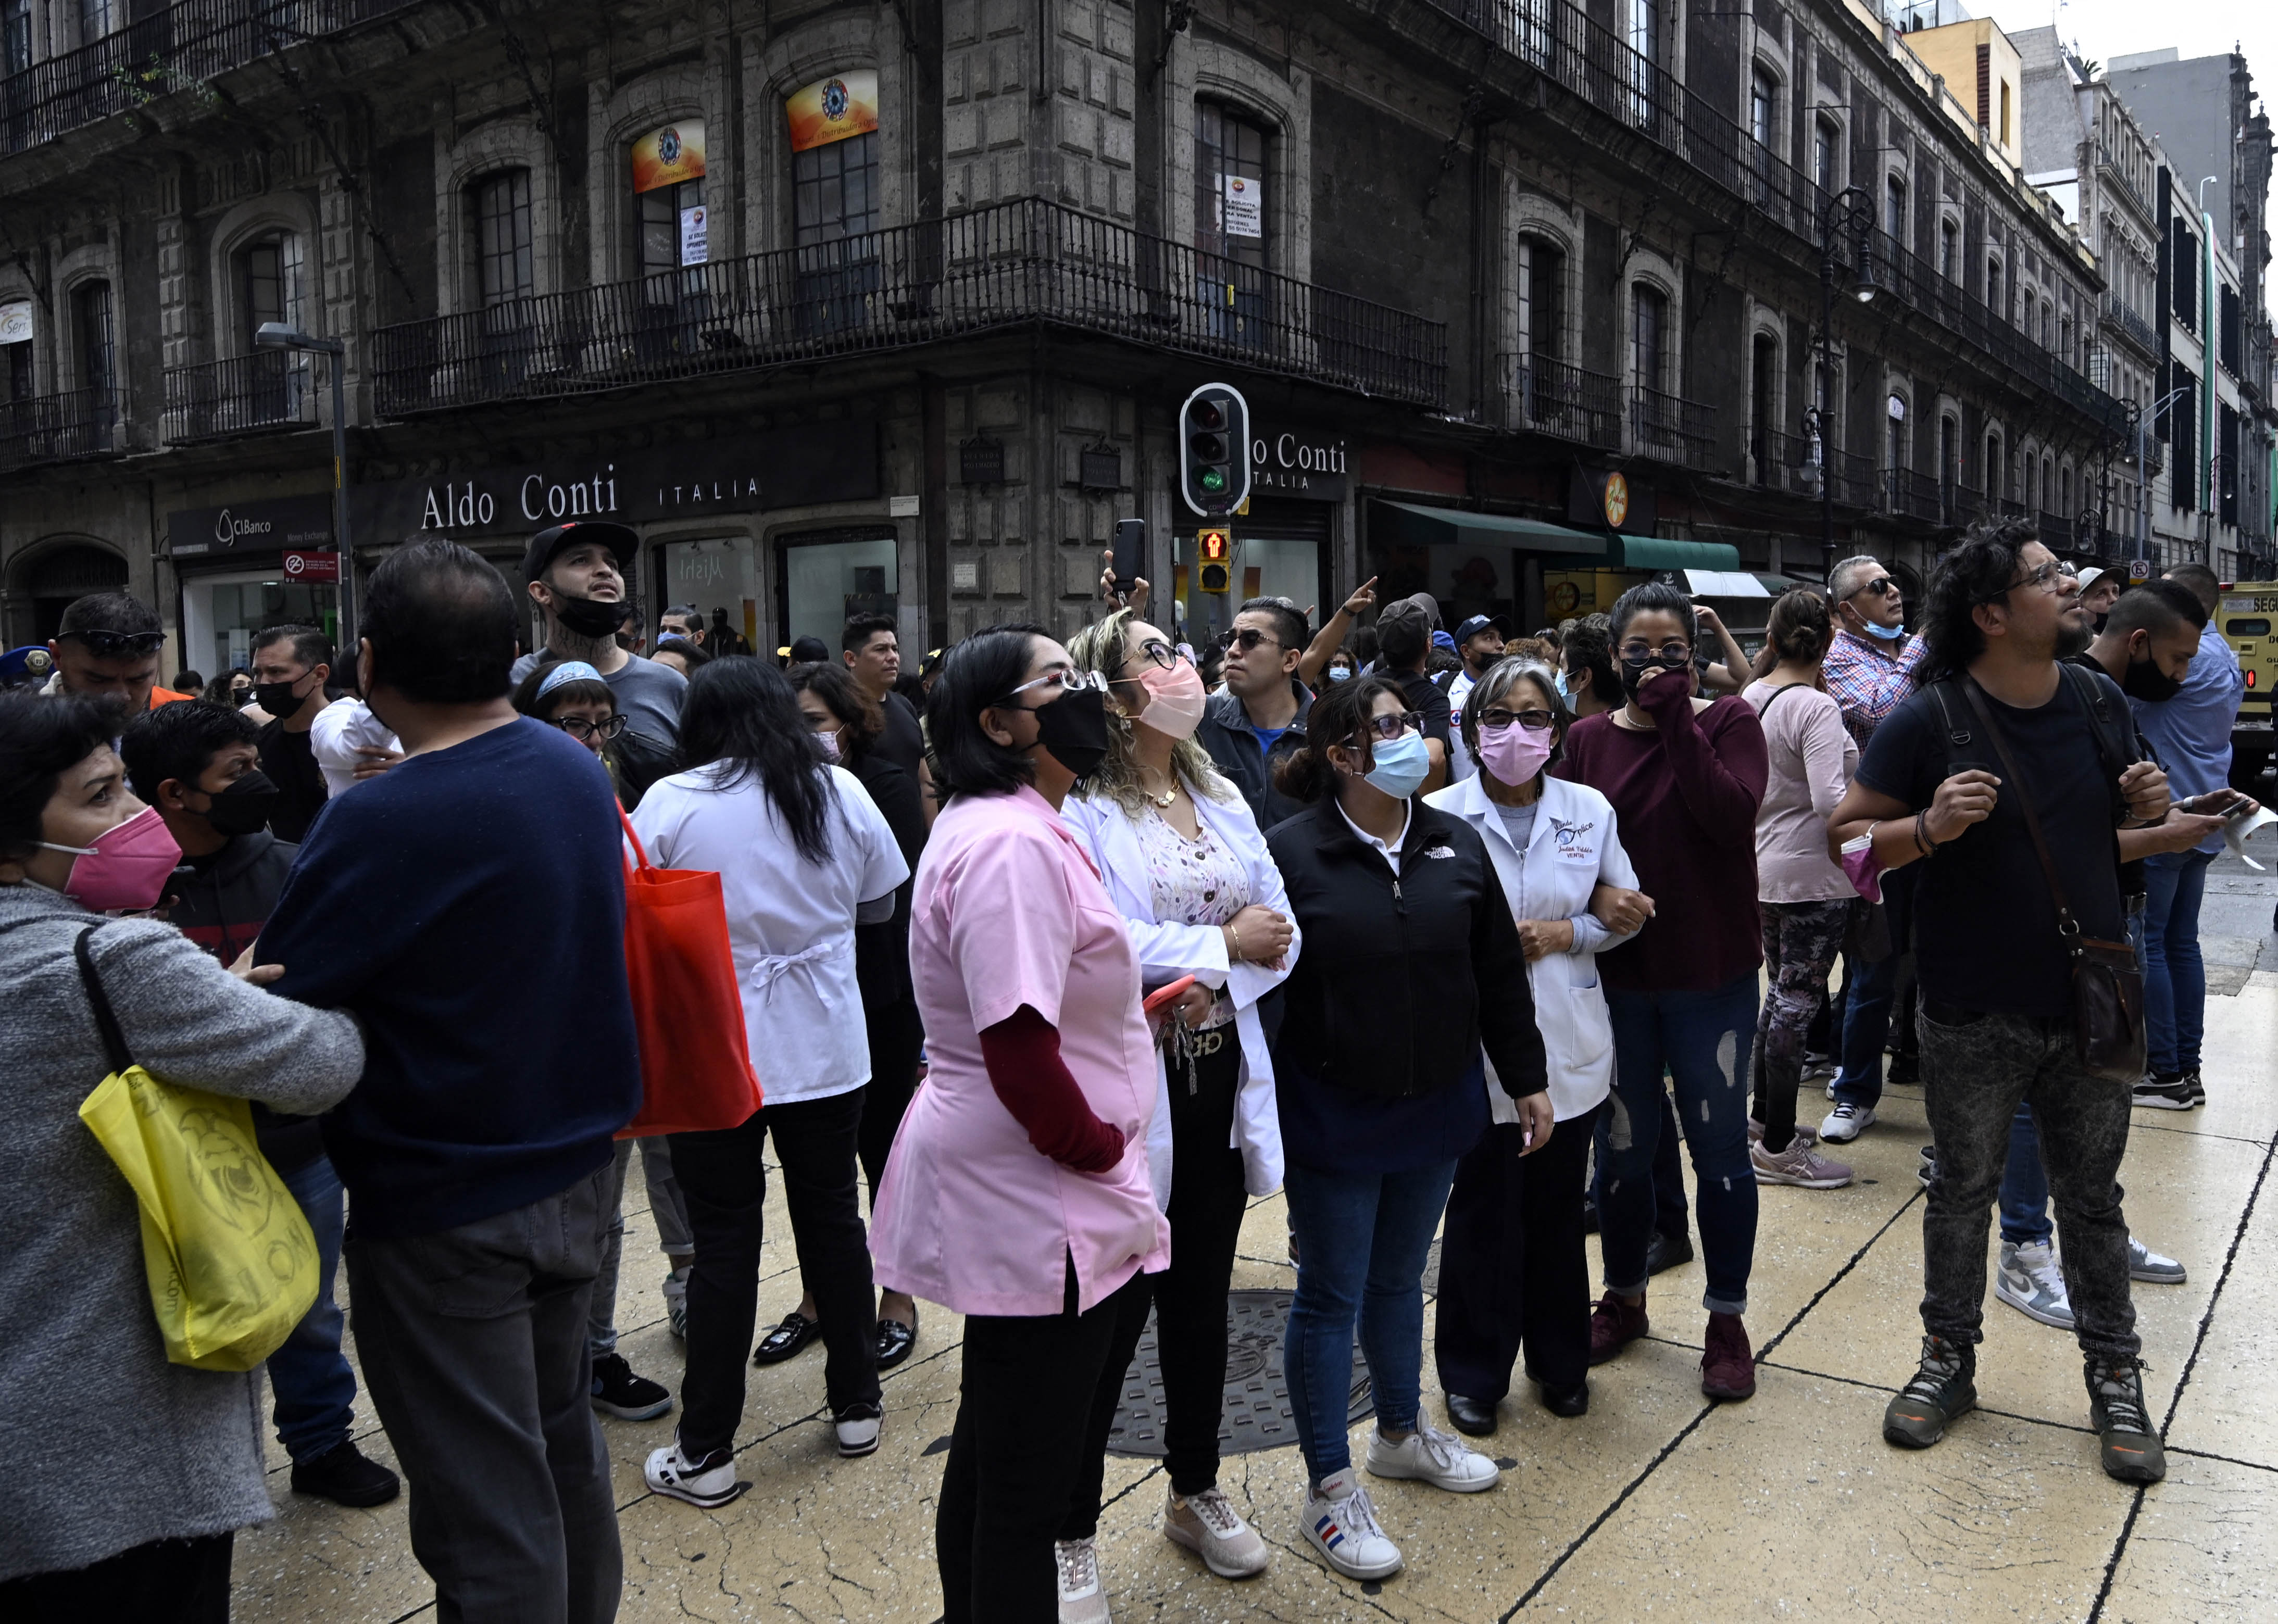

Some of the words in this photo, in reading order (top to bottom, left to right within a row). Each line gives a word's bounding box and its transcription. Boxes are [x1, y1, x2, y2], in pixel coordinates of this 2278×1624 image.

[1278, 433, 1346, 473] Conti
[421, 481, 493, 530] Aldo
[521, 464, 617, 520] Conti
[660, 477, 757, 506] ITALIA
[235, 519, 271, 535] CIBanco
[287, 533, 303, 542] Money
[304, 531, 329, 541] Exchange
